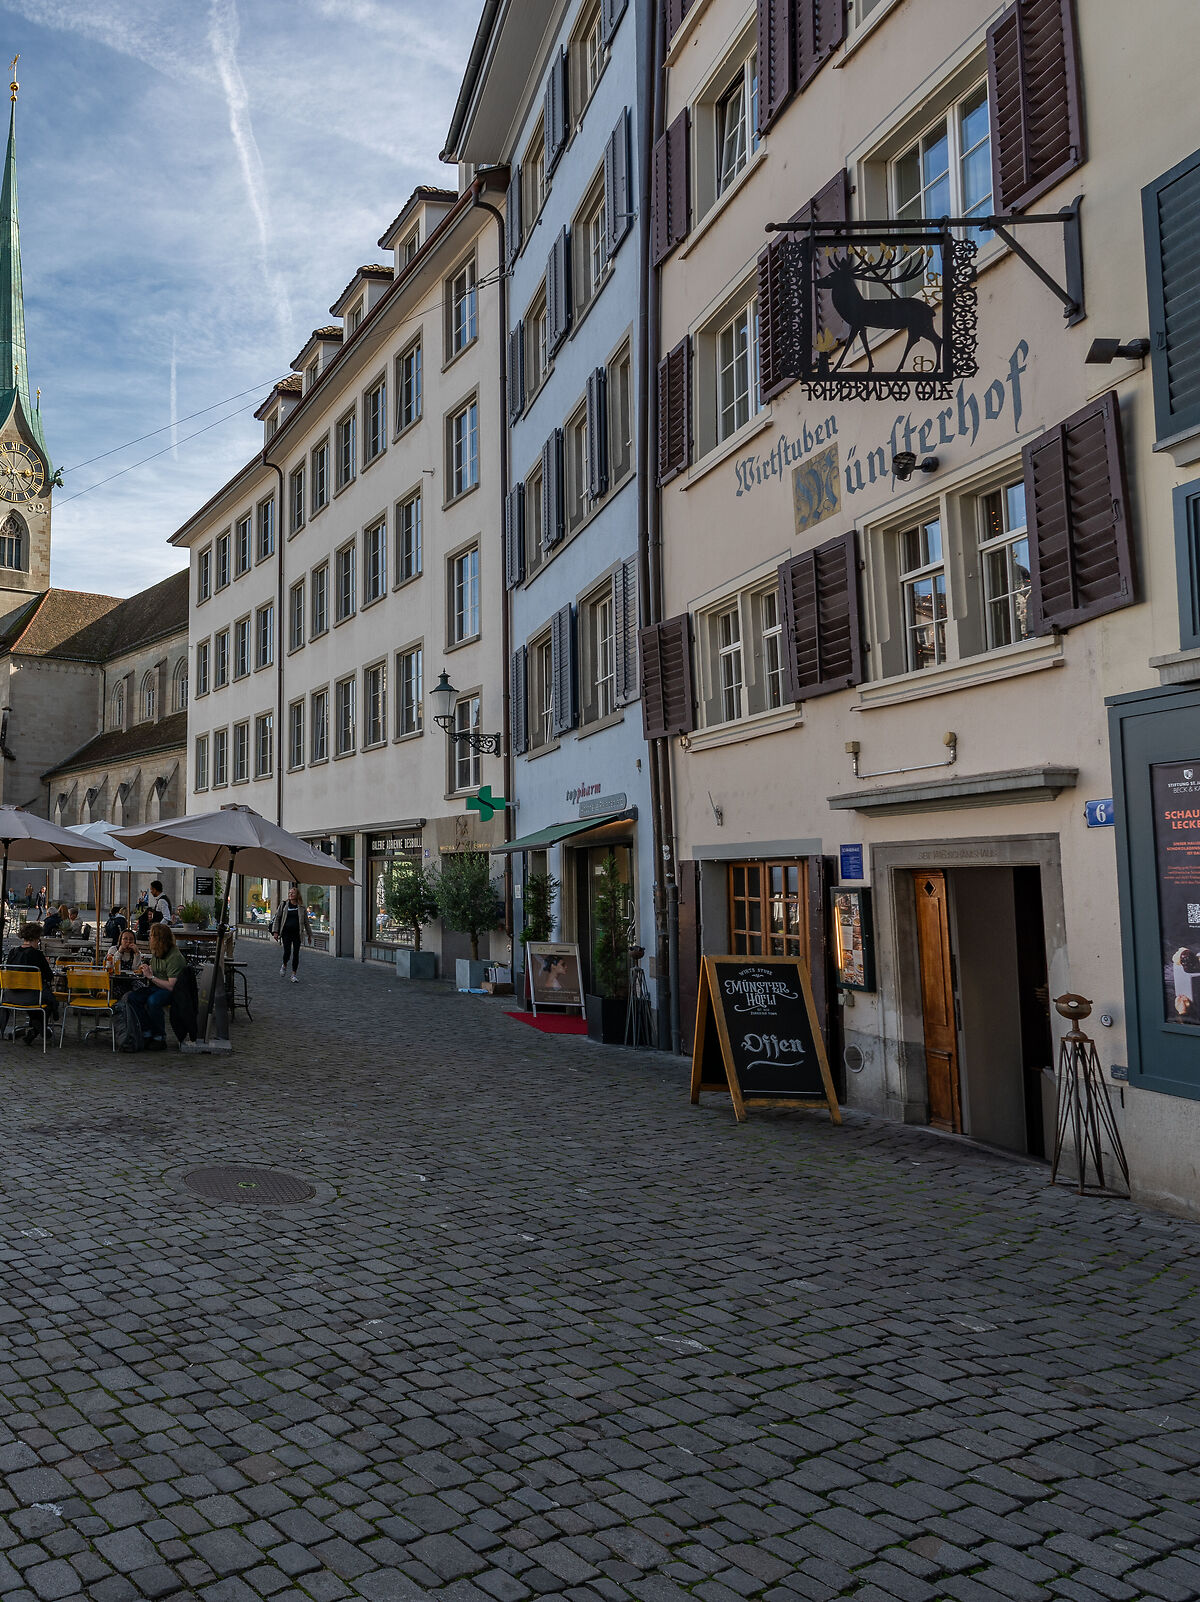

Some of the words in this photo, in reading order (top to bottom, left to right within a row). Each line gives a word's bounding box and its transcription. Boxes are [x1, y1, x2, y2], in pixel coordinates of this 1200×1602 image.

[566, 782, 601, 805] toppharm
[1096, 803, 1107, 823] 6
[1164, 809, 1200, 820] SCHAU
[371, 840, 385, 851] GALERIE
[386, 838, 403, 850] ADRIENNE
[724, 979, 798, 999] MÜNSTER
[745, 992, 777, 1008] HÖFLI
[741, 1033, 806, 1059] Offen
